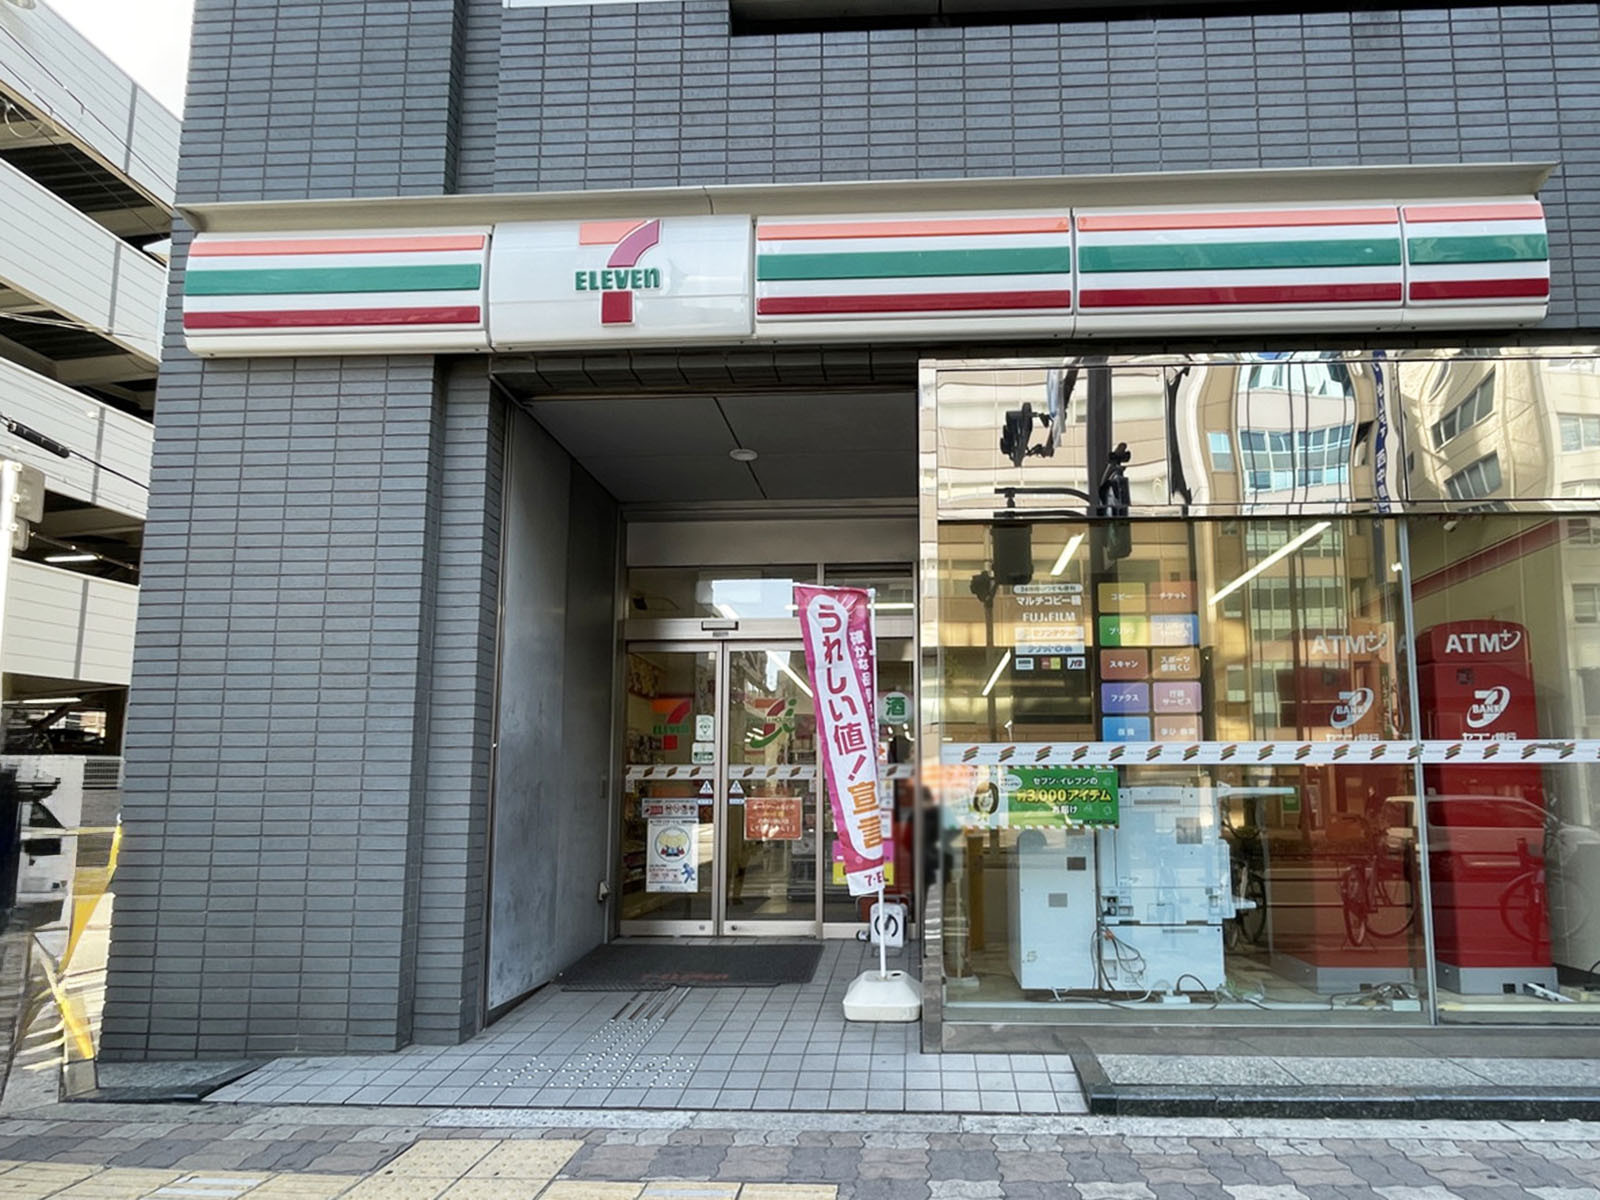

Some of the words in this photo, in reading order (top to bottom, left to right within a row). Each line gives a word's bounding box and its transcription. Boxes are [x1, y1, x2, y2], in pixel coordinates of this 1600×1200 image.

[1111, 592, 1134, 600] コピー
[1110, 660, 1138, 668] スキャン
[1111, 694, 1139, 702] ファクス
[886, 697, 905, 715] 酒
